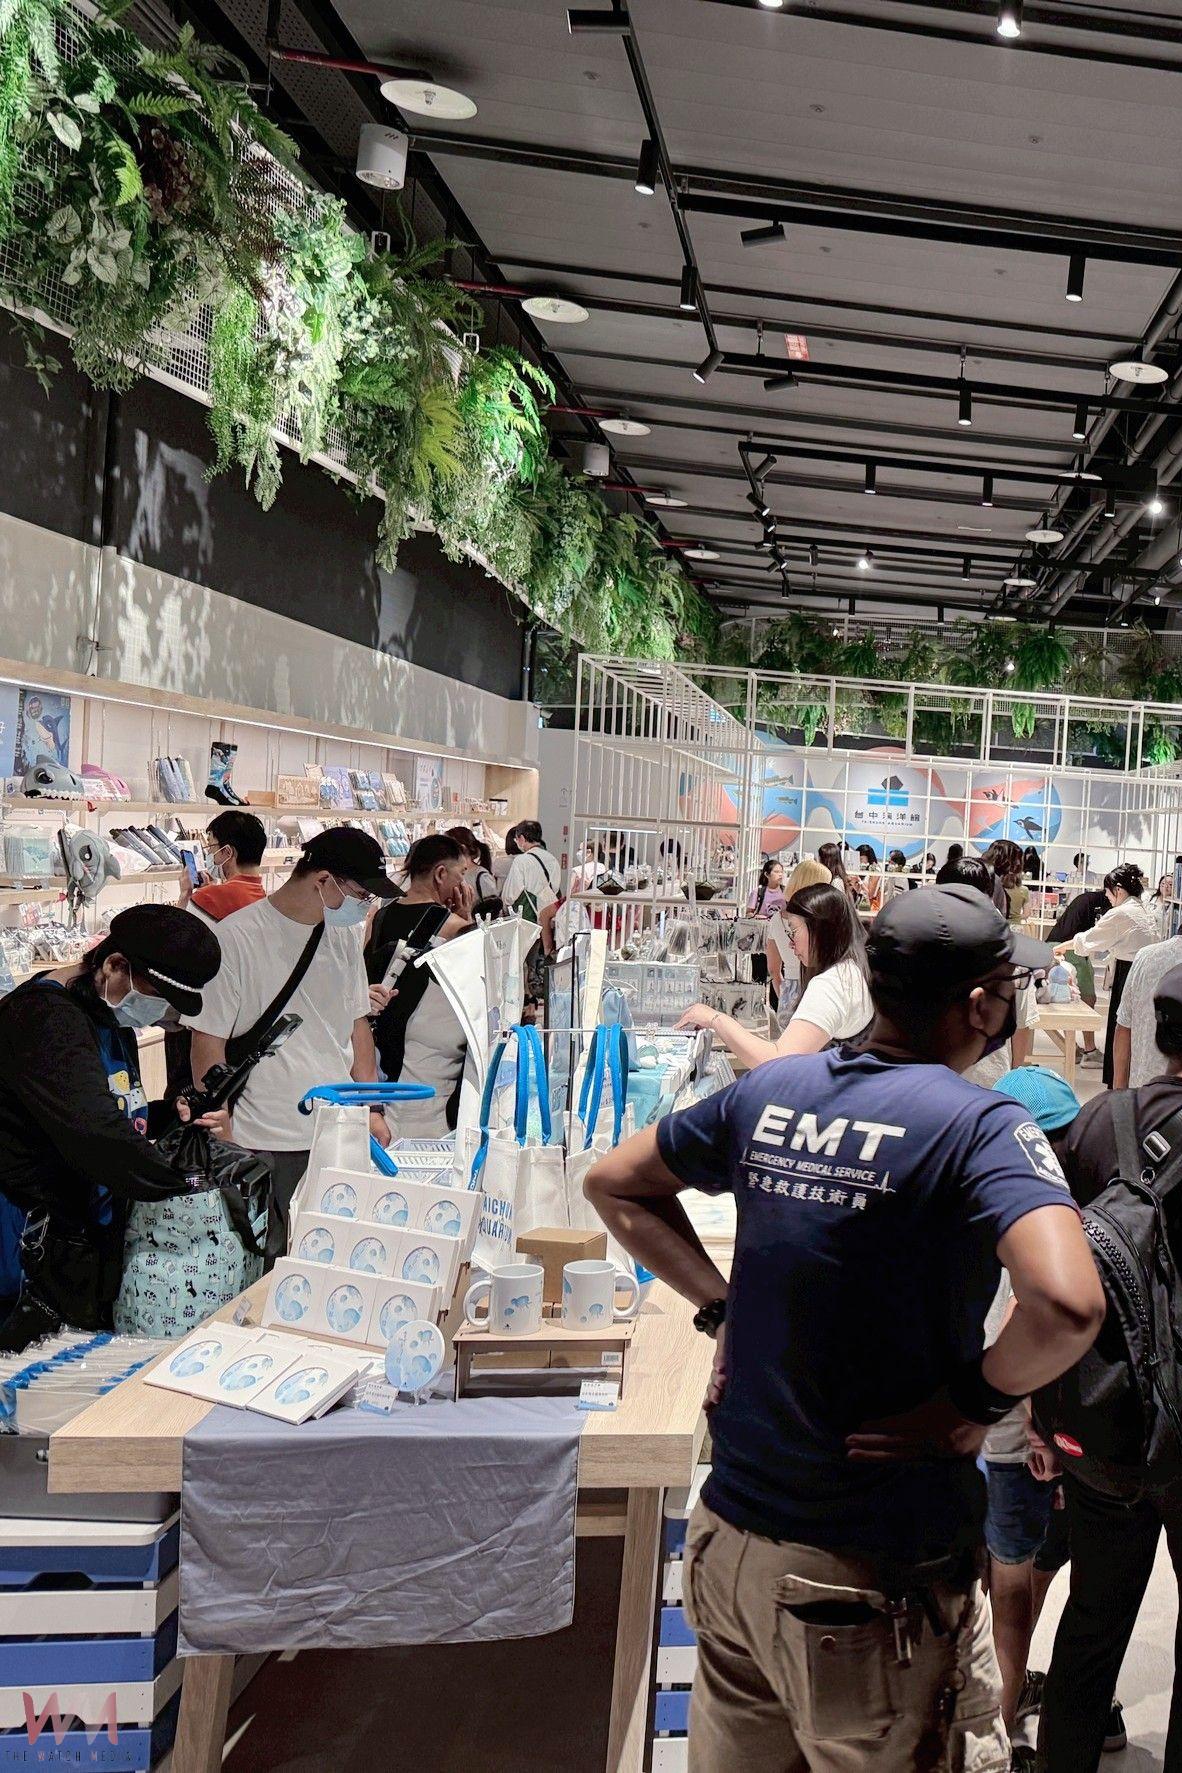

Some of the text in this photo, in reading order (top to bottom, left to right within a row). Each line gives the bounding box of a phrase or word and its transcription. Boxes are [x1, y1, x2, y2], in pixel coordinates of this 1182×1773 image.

[752, 1104, 907, 1162] EMT
[750, 1150, 878, 1182] EMERGENCY MEDICAL SERVICE
[748, 1171, 867, 1210] 緊急救護技術員
